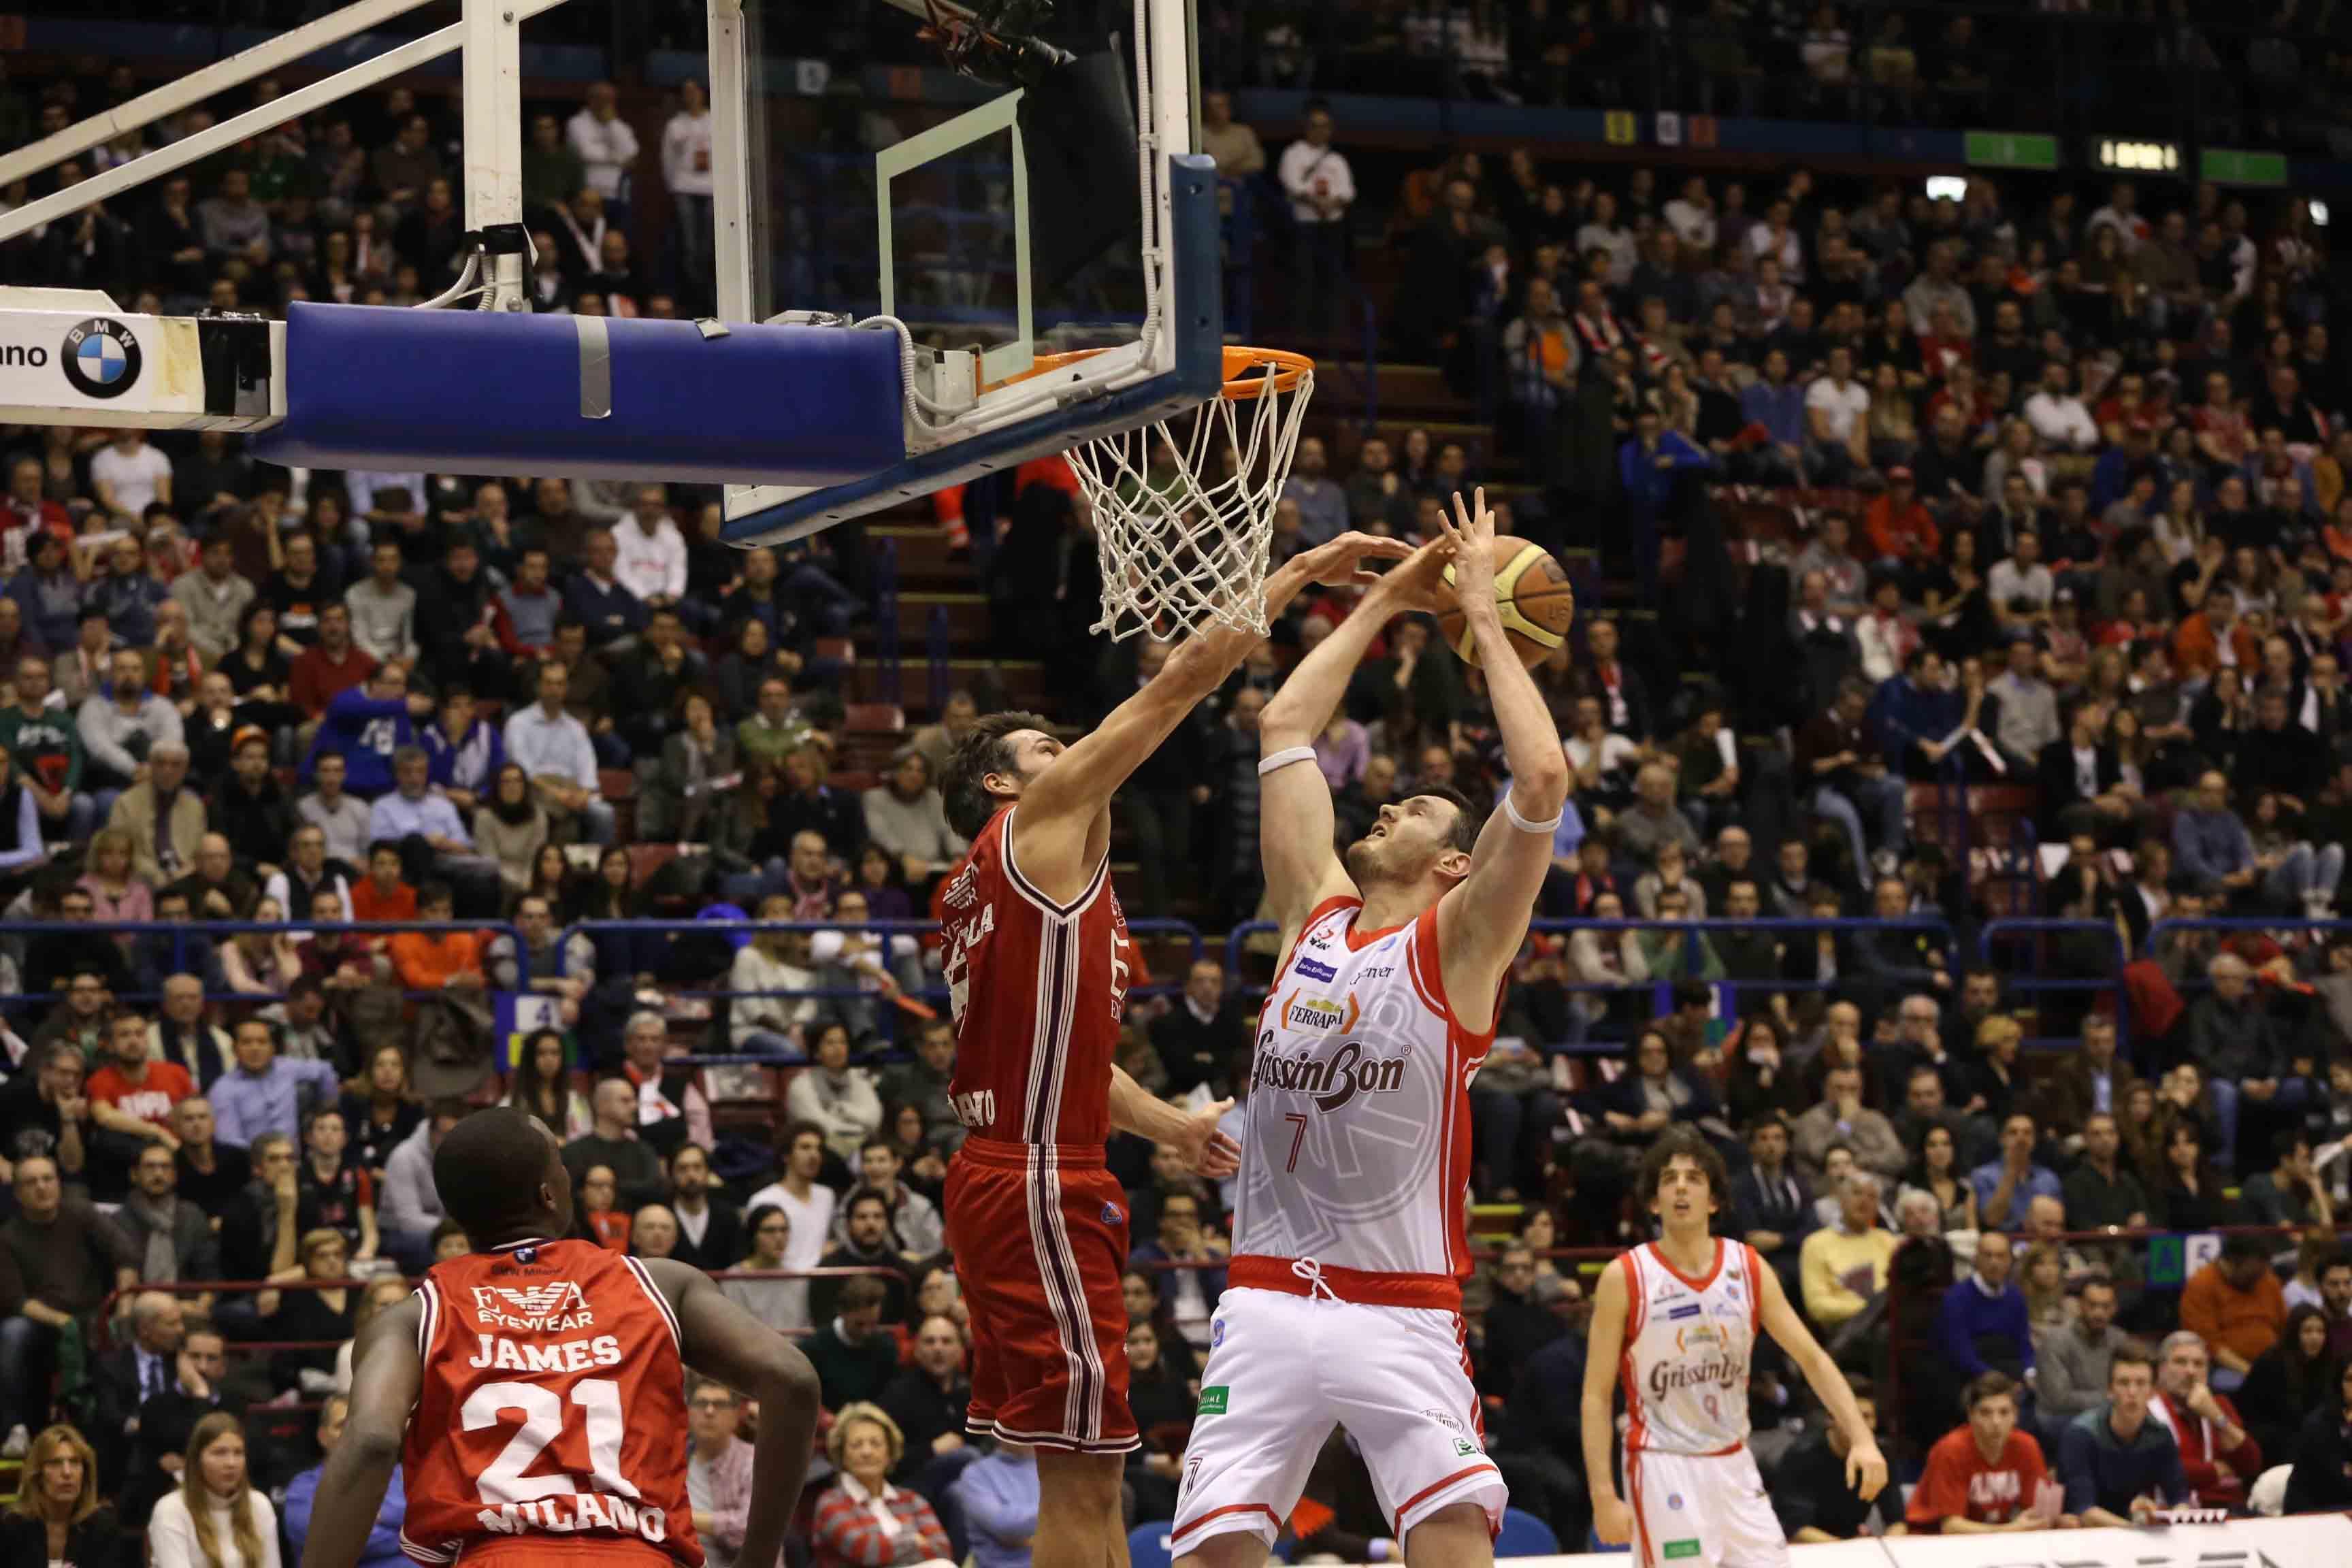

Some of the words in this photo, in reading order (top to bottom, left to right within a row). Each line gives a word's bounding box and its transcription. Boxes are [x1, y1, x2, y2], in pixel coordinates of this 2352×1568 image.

[69, 320, 136, 348] BMW
[0, 344, 48, 367] no
[1285, 1112, 1307, 1174] 7
[476, 1309, 594, 1331] EYEWEAR
[469, 1333, 622, 1373] JAMES
[461, 1378, 641, 1505] 21
[476, 1493, 666, 1544] MILANO
